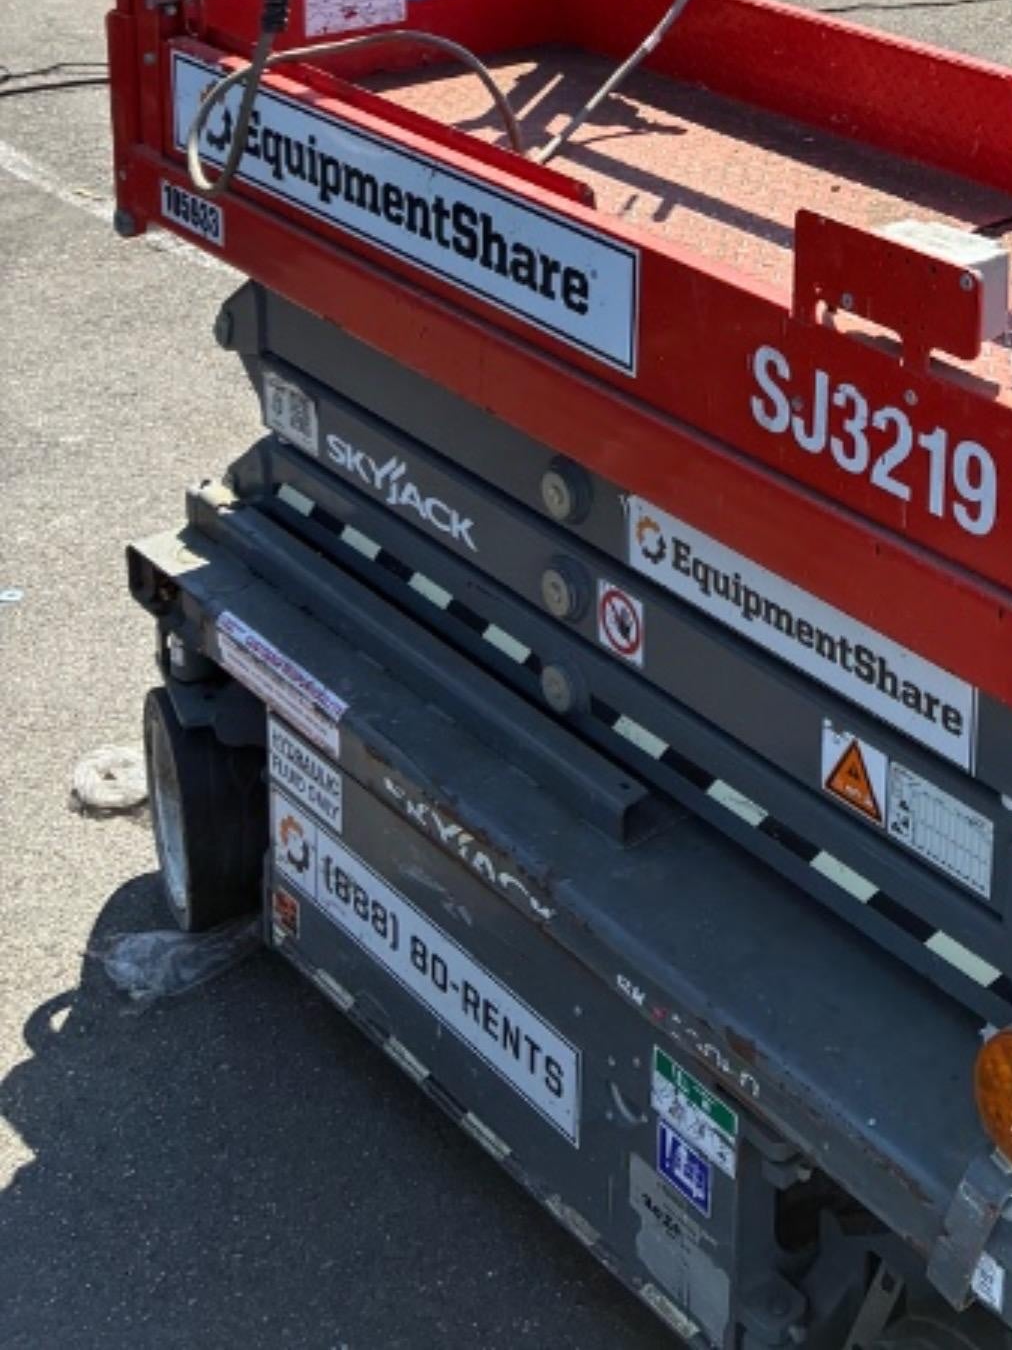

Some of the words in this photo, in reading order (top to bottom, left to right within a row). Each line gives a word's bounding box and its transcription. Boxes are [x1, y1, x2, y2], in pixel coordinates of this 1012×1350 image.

[243, 111, 589, 316] EquipmentShare
[325, 433, 478, 552] SKYJACK
[751, 344, 998, 536] SJ3219
[670, 535, 964, 737] EquipmentShare
[322, 854, 400, 952] (888)
[409, 934, 565, 1100] 80-RENTS
